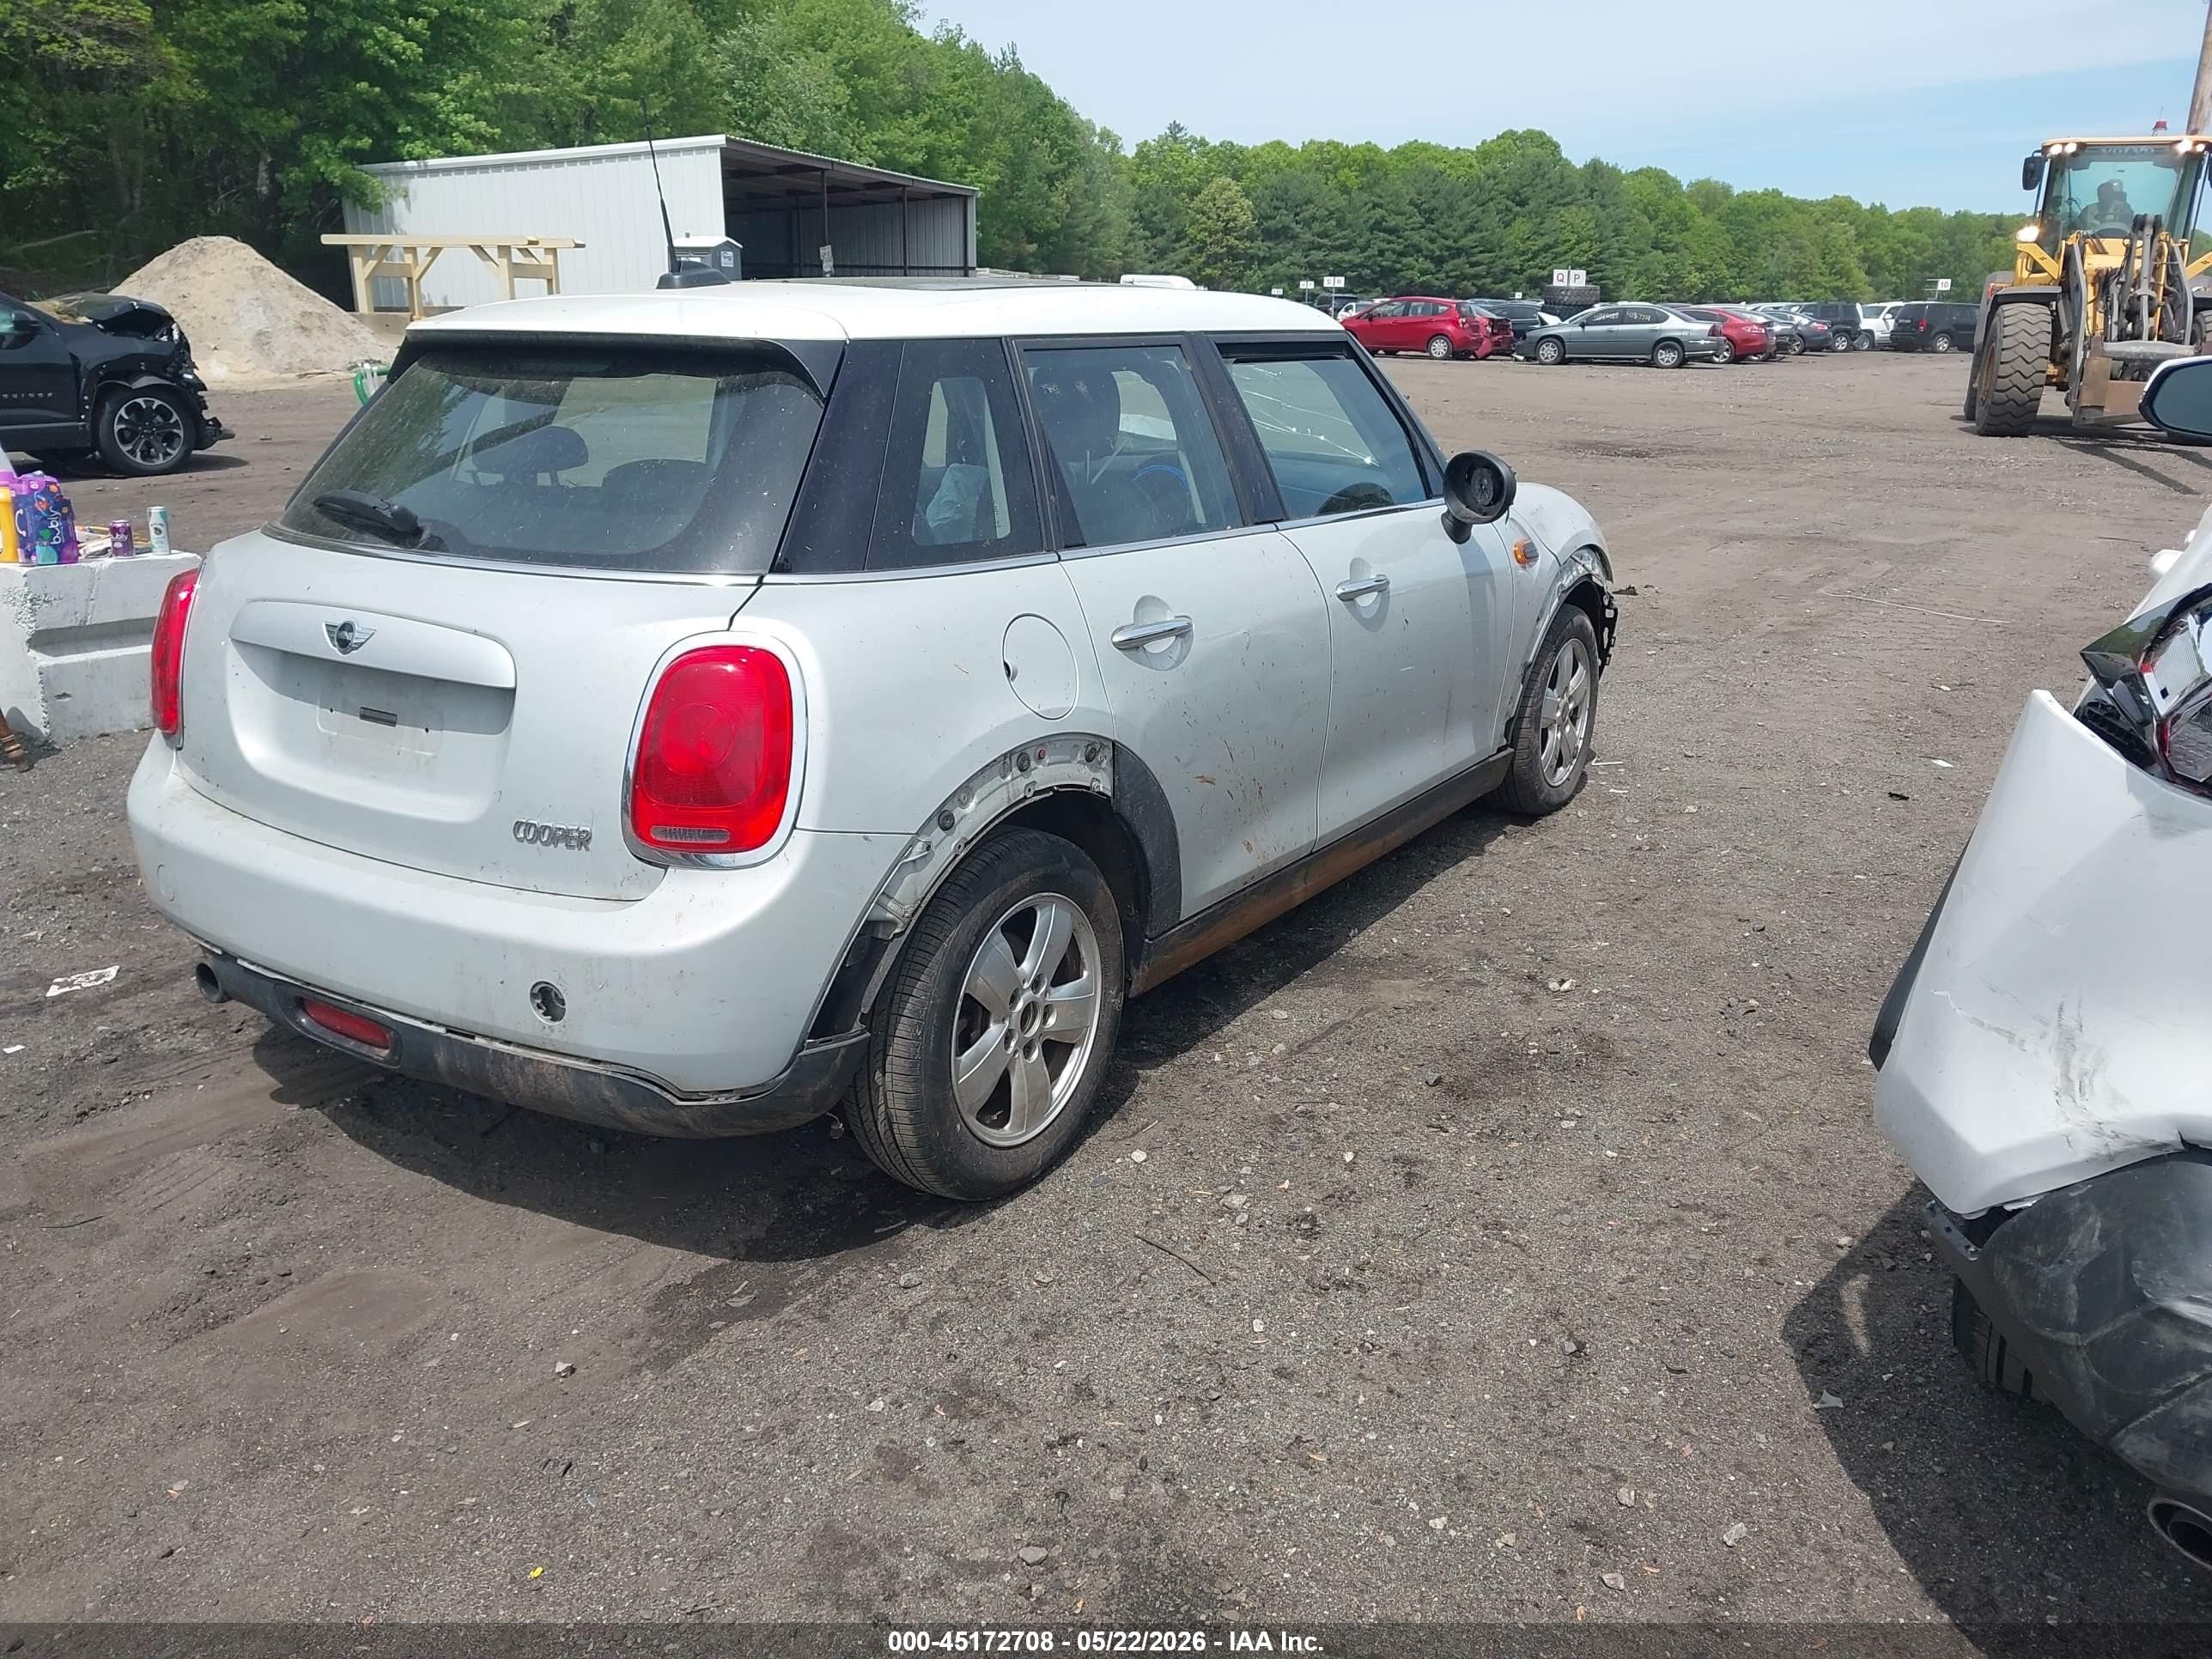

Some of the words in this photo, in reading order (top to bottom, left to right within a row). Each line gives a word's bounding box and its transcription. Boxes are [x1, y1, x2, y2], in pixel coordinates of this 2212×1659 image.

[1557, 272, 1565, 283] Q
[1574, 274, 1581, 283] P
[47, 506, 62, 544] bubly
[513, 819, 592, 853] COOPER
